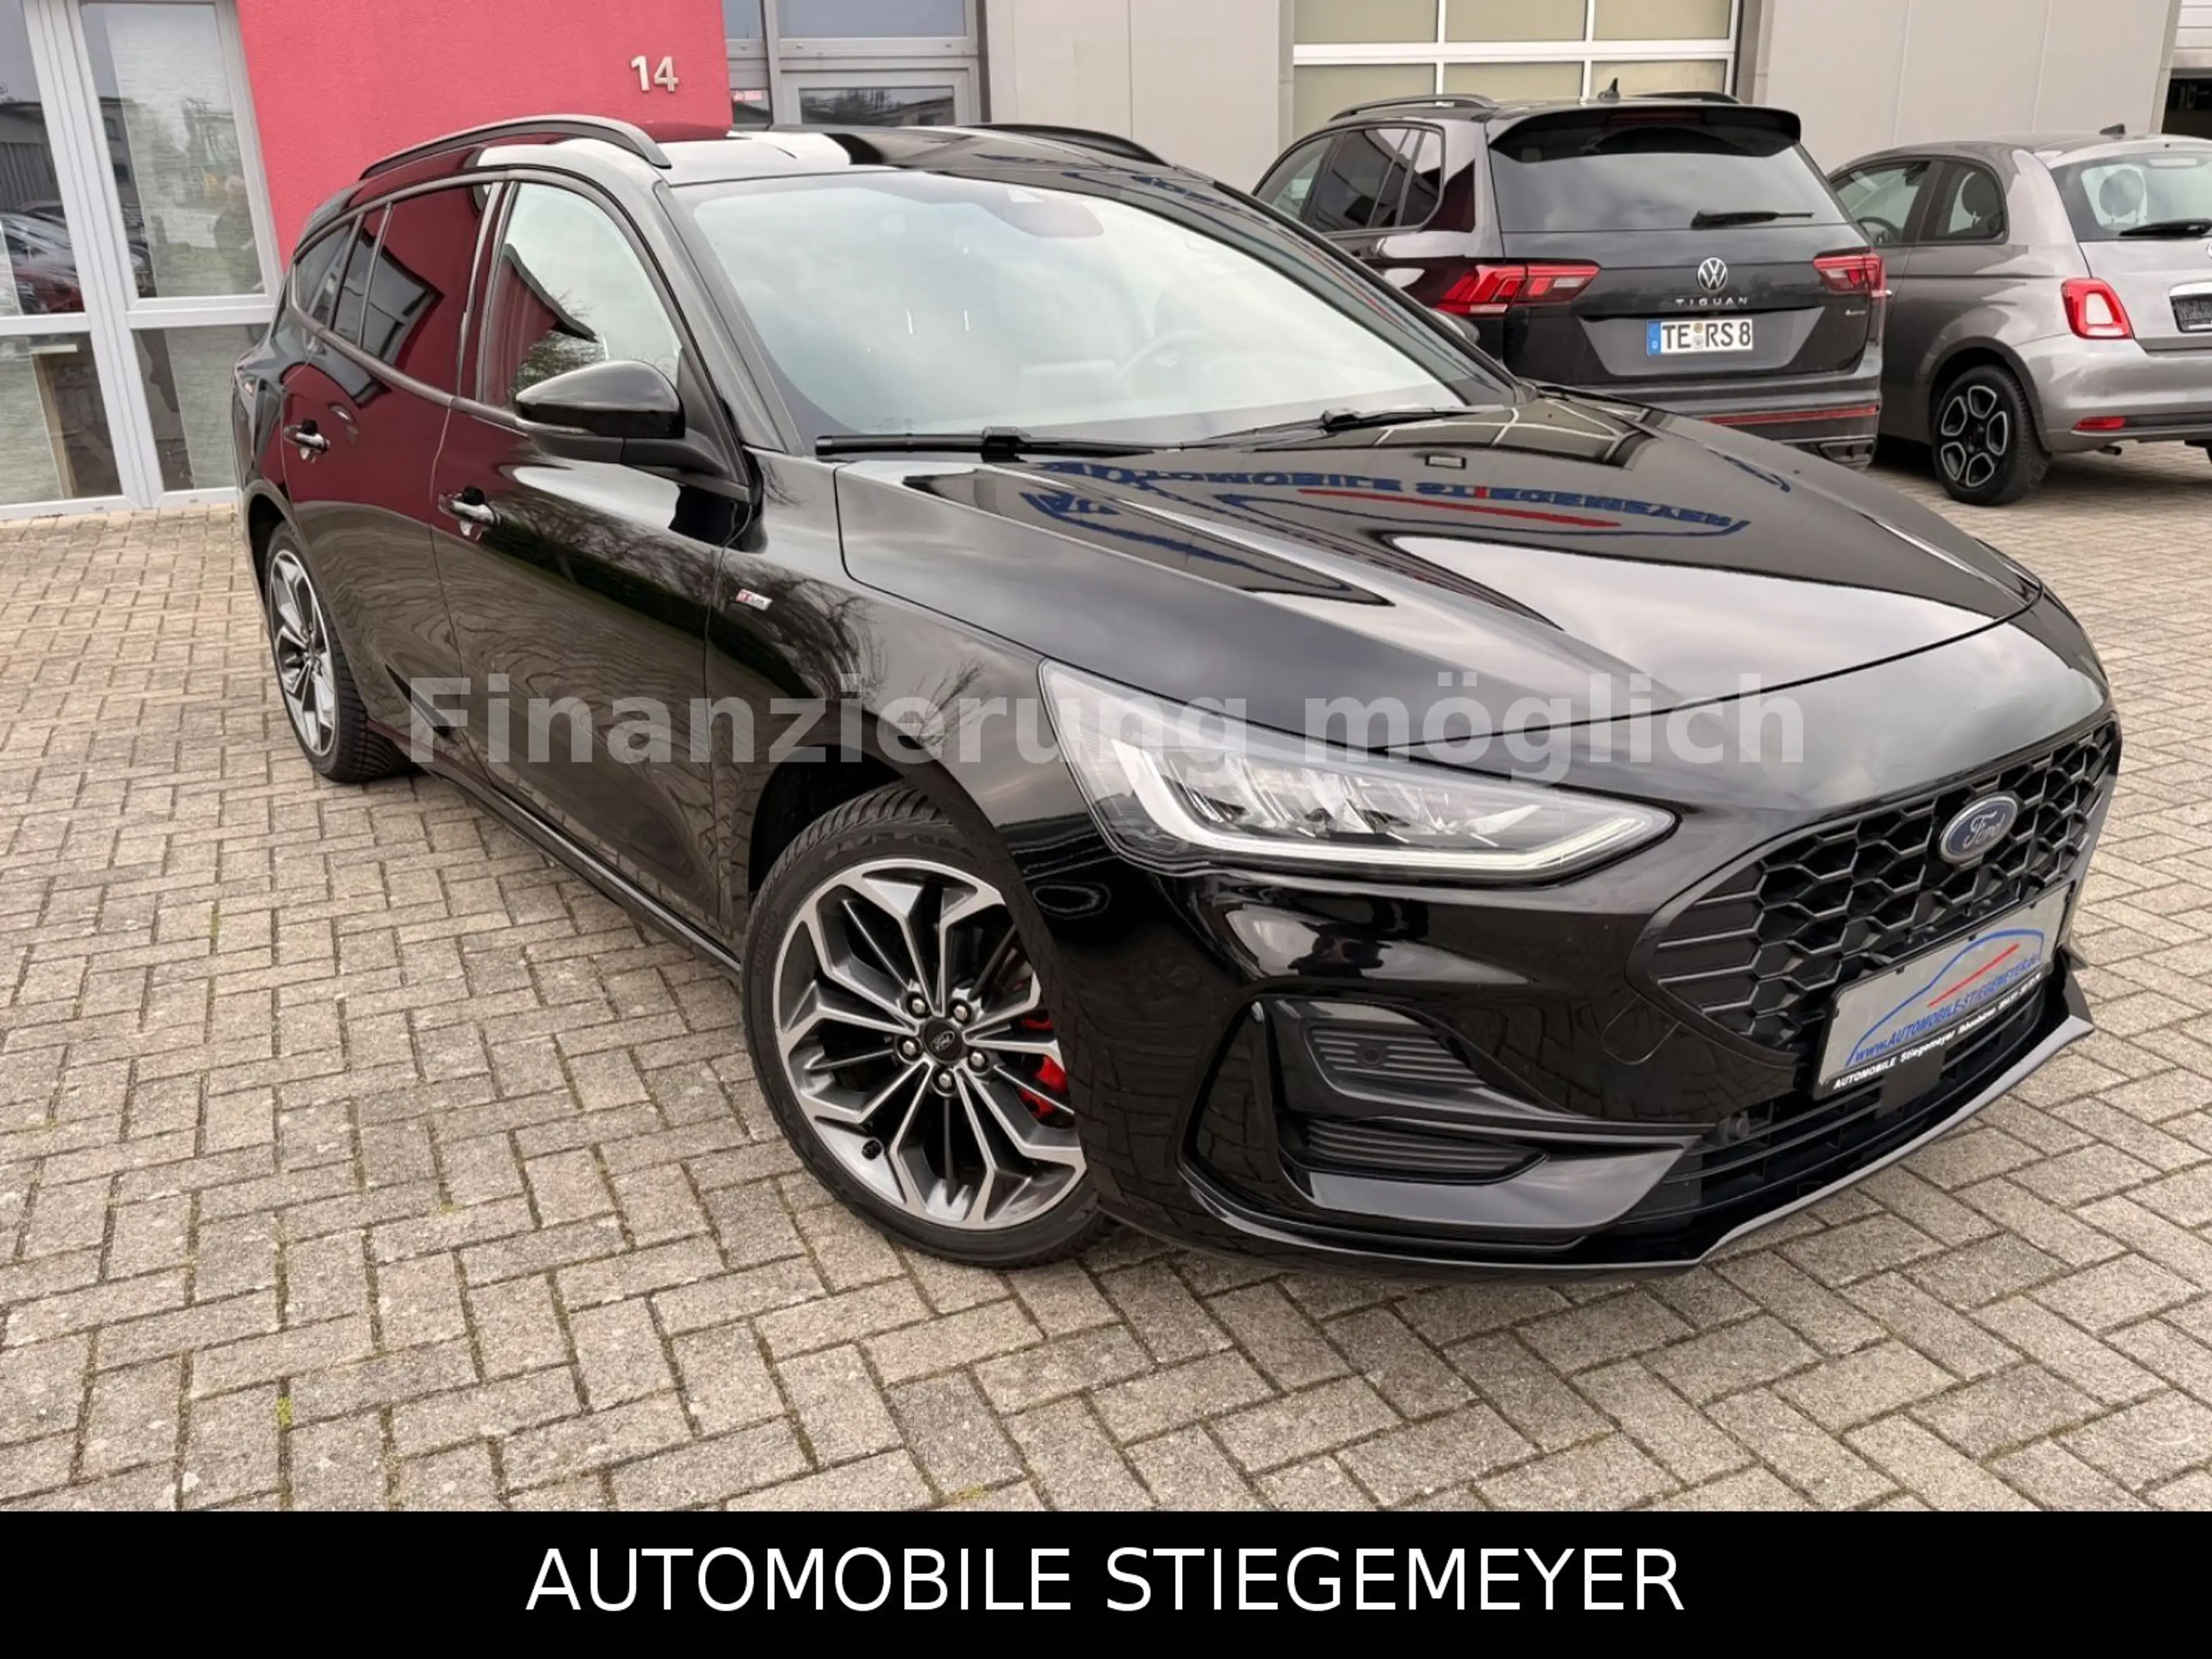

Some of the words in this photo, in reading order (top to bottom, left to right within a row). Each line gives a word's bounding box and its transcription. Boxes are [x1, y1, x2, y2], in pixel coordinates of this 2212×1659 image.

[631, 55, 679, 92] 14
[1676, 297, 1748, 306] TIGUAN
[1662, 324, 1691, 349] TE
[1706, 322, 1734, 347] RS
[1739, 321, 1751, 347] 8
[1963, 809, 2006, 850] Ford
